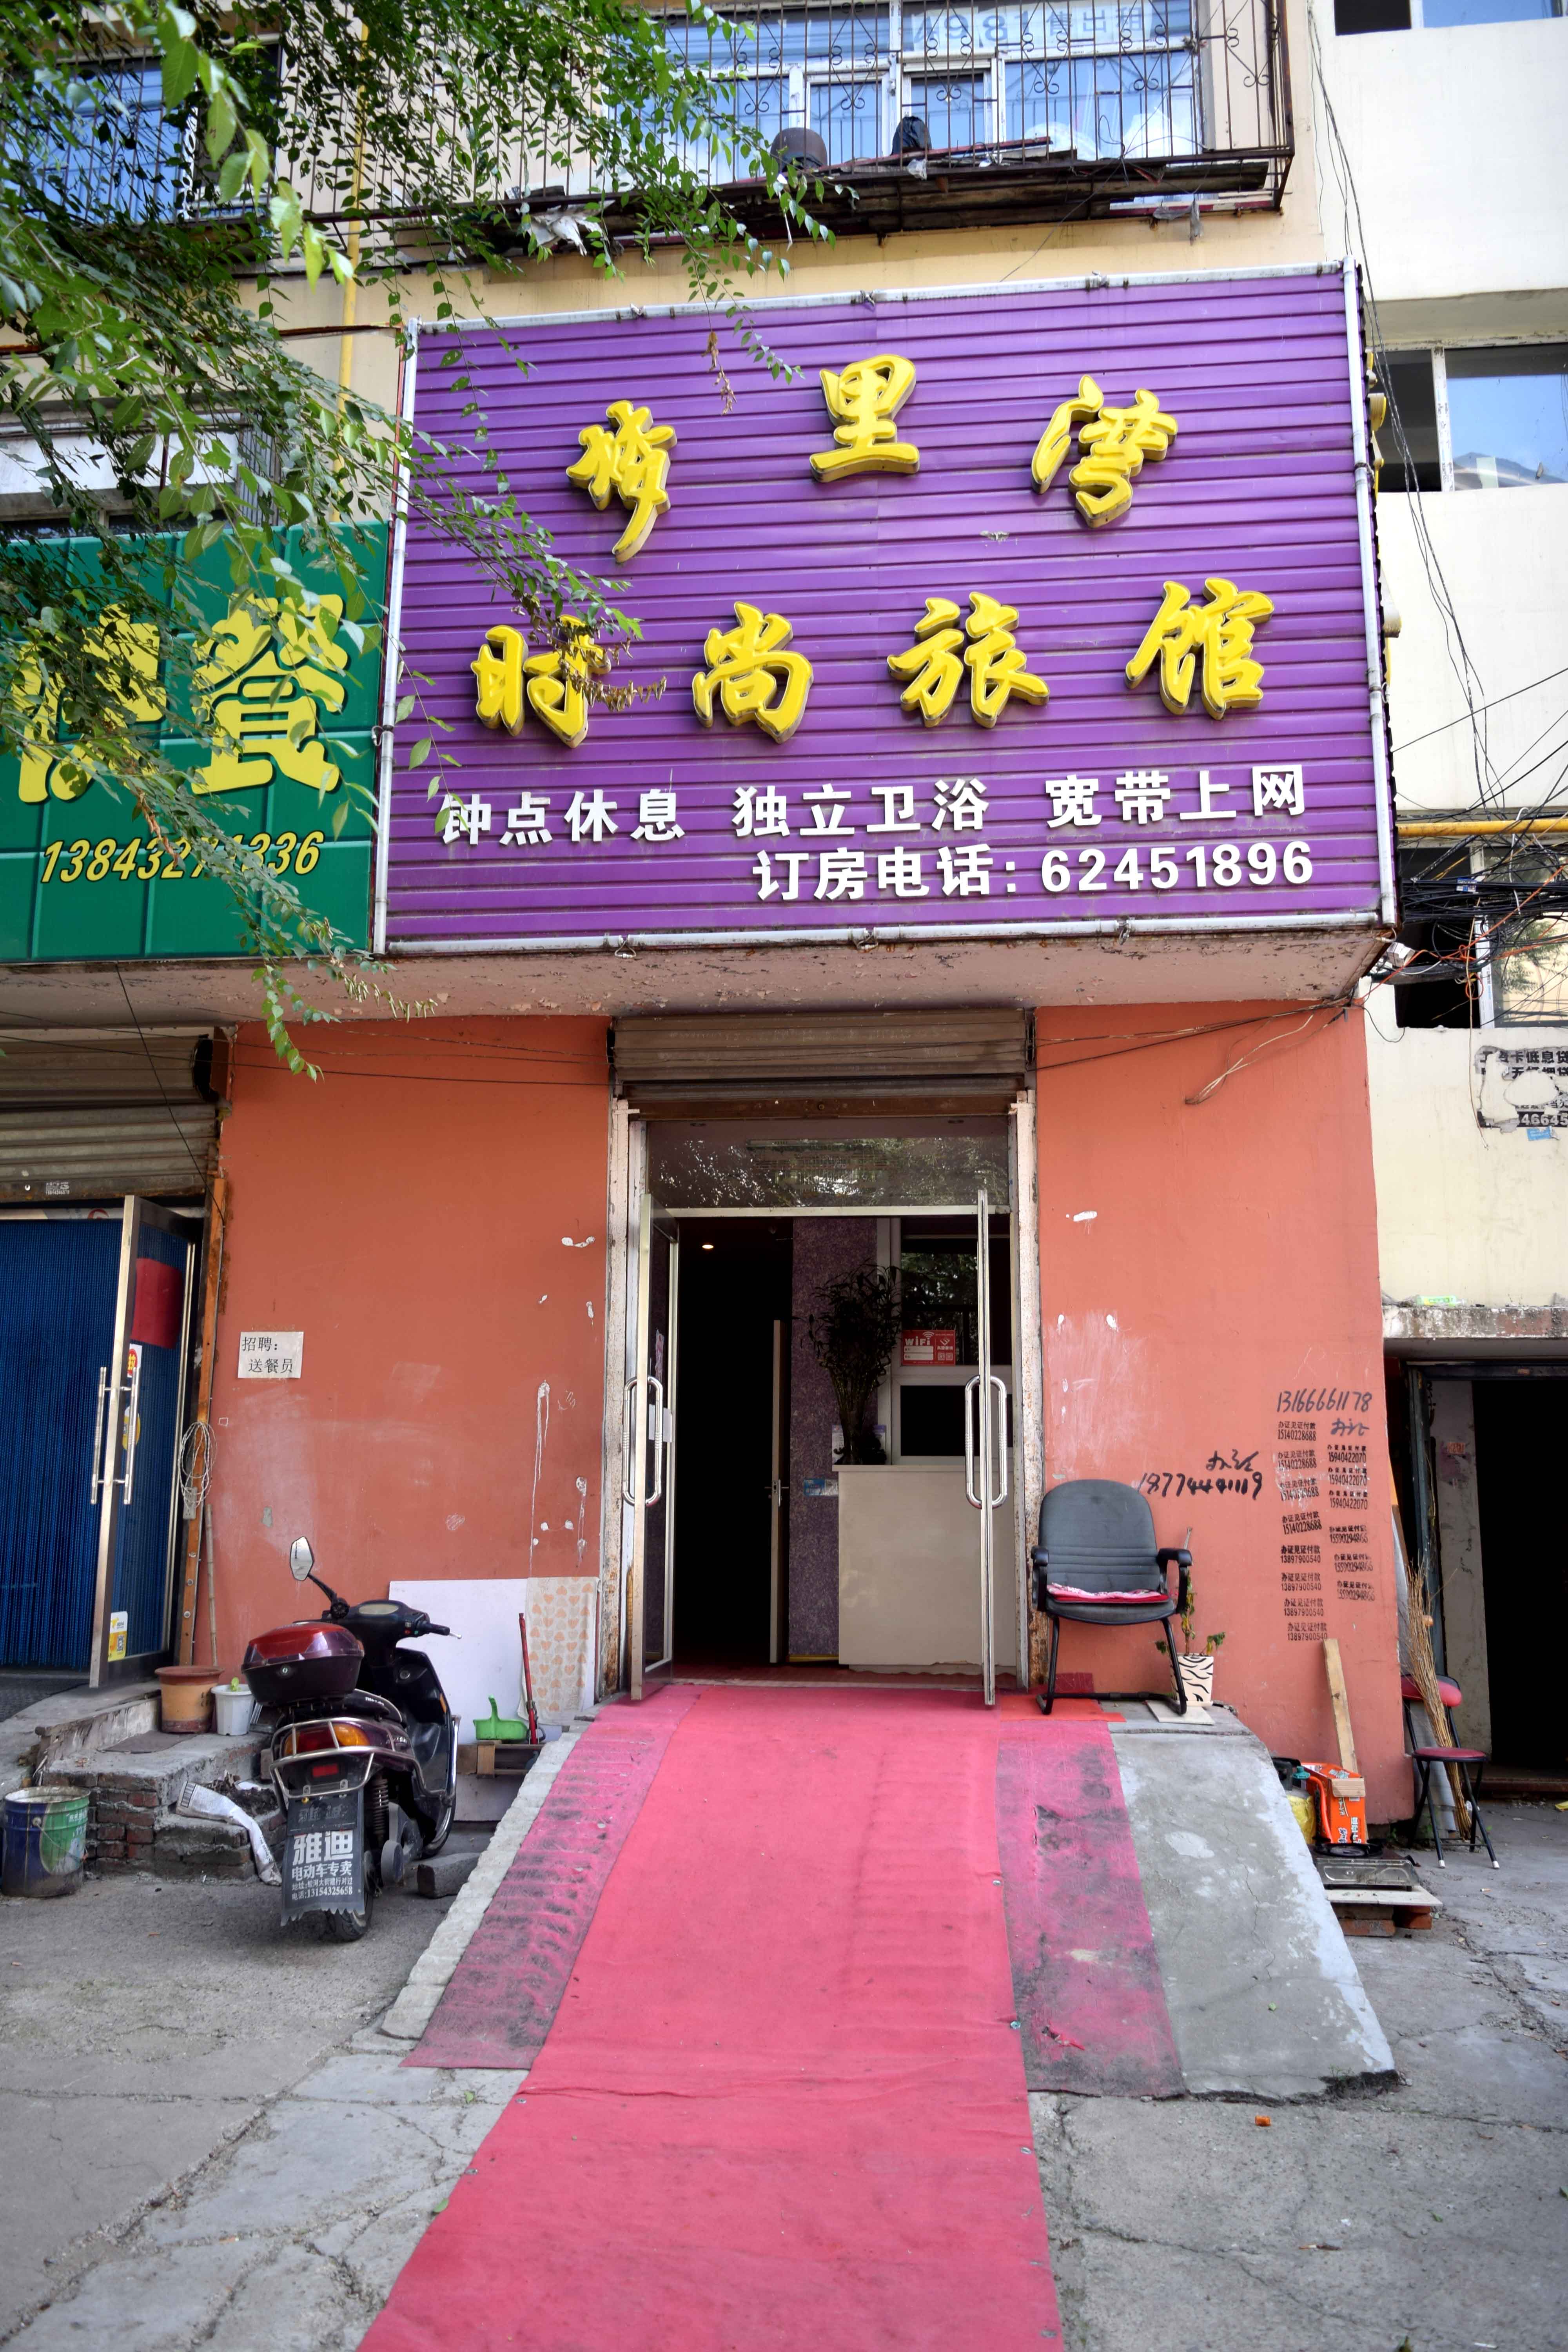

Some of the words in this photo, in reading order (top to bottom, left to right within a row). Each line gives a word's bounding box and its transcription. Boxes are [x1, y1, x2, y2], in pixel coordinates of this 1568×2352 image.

[566, 354, 1178, 564] 梦里湾
[471, 577, 1274, 748] 时尚旅馆
[442, 789, 684, 845] 钟点休息
[732, 778, 990, 837] 独立卫浴
[1045, 764, 1306, 828] 宽带上网
[242, 1337, 278, 1351] 招聘：
[248, 1358, 292, 1373] 送餐员
[1278, 1421, 1316, 1429] 办证见证付款
[1278, 1430, 1316, 1441] 15140228688
[1278, 1450, 1315, 1459] 办证见证付款
[1328, 1452, 1367, 1463] 15940422070
[1330, 1498, 1368, 1509] 15940422070
[1282, 1511, 1319, 1523] 办证见证付款
[1283, 1519, 1322, 1535] 15140228688
[1281, 1545, 1320, 1554] 办证见证付款
[1281, 1573, 1321, 1582] 办证见证付款
[1281, 1583, 1321, 1591] 13897900540
[1284, 1598, 1324, 1607] 办证见证付款
[1284, 1608, 1324, 1616] 13897900540
[1288, 1622, 1327, 1631] 办证见证付款
[1288, 1632, 1328, 1641] 13897900540
[292, 1831, 353, 1866] 雅迪
[292, 1861, 352, 1881] 电动车专卖
